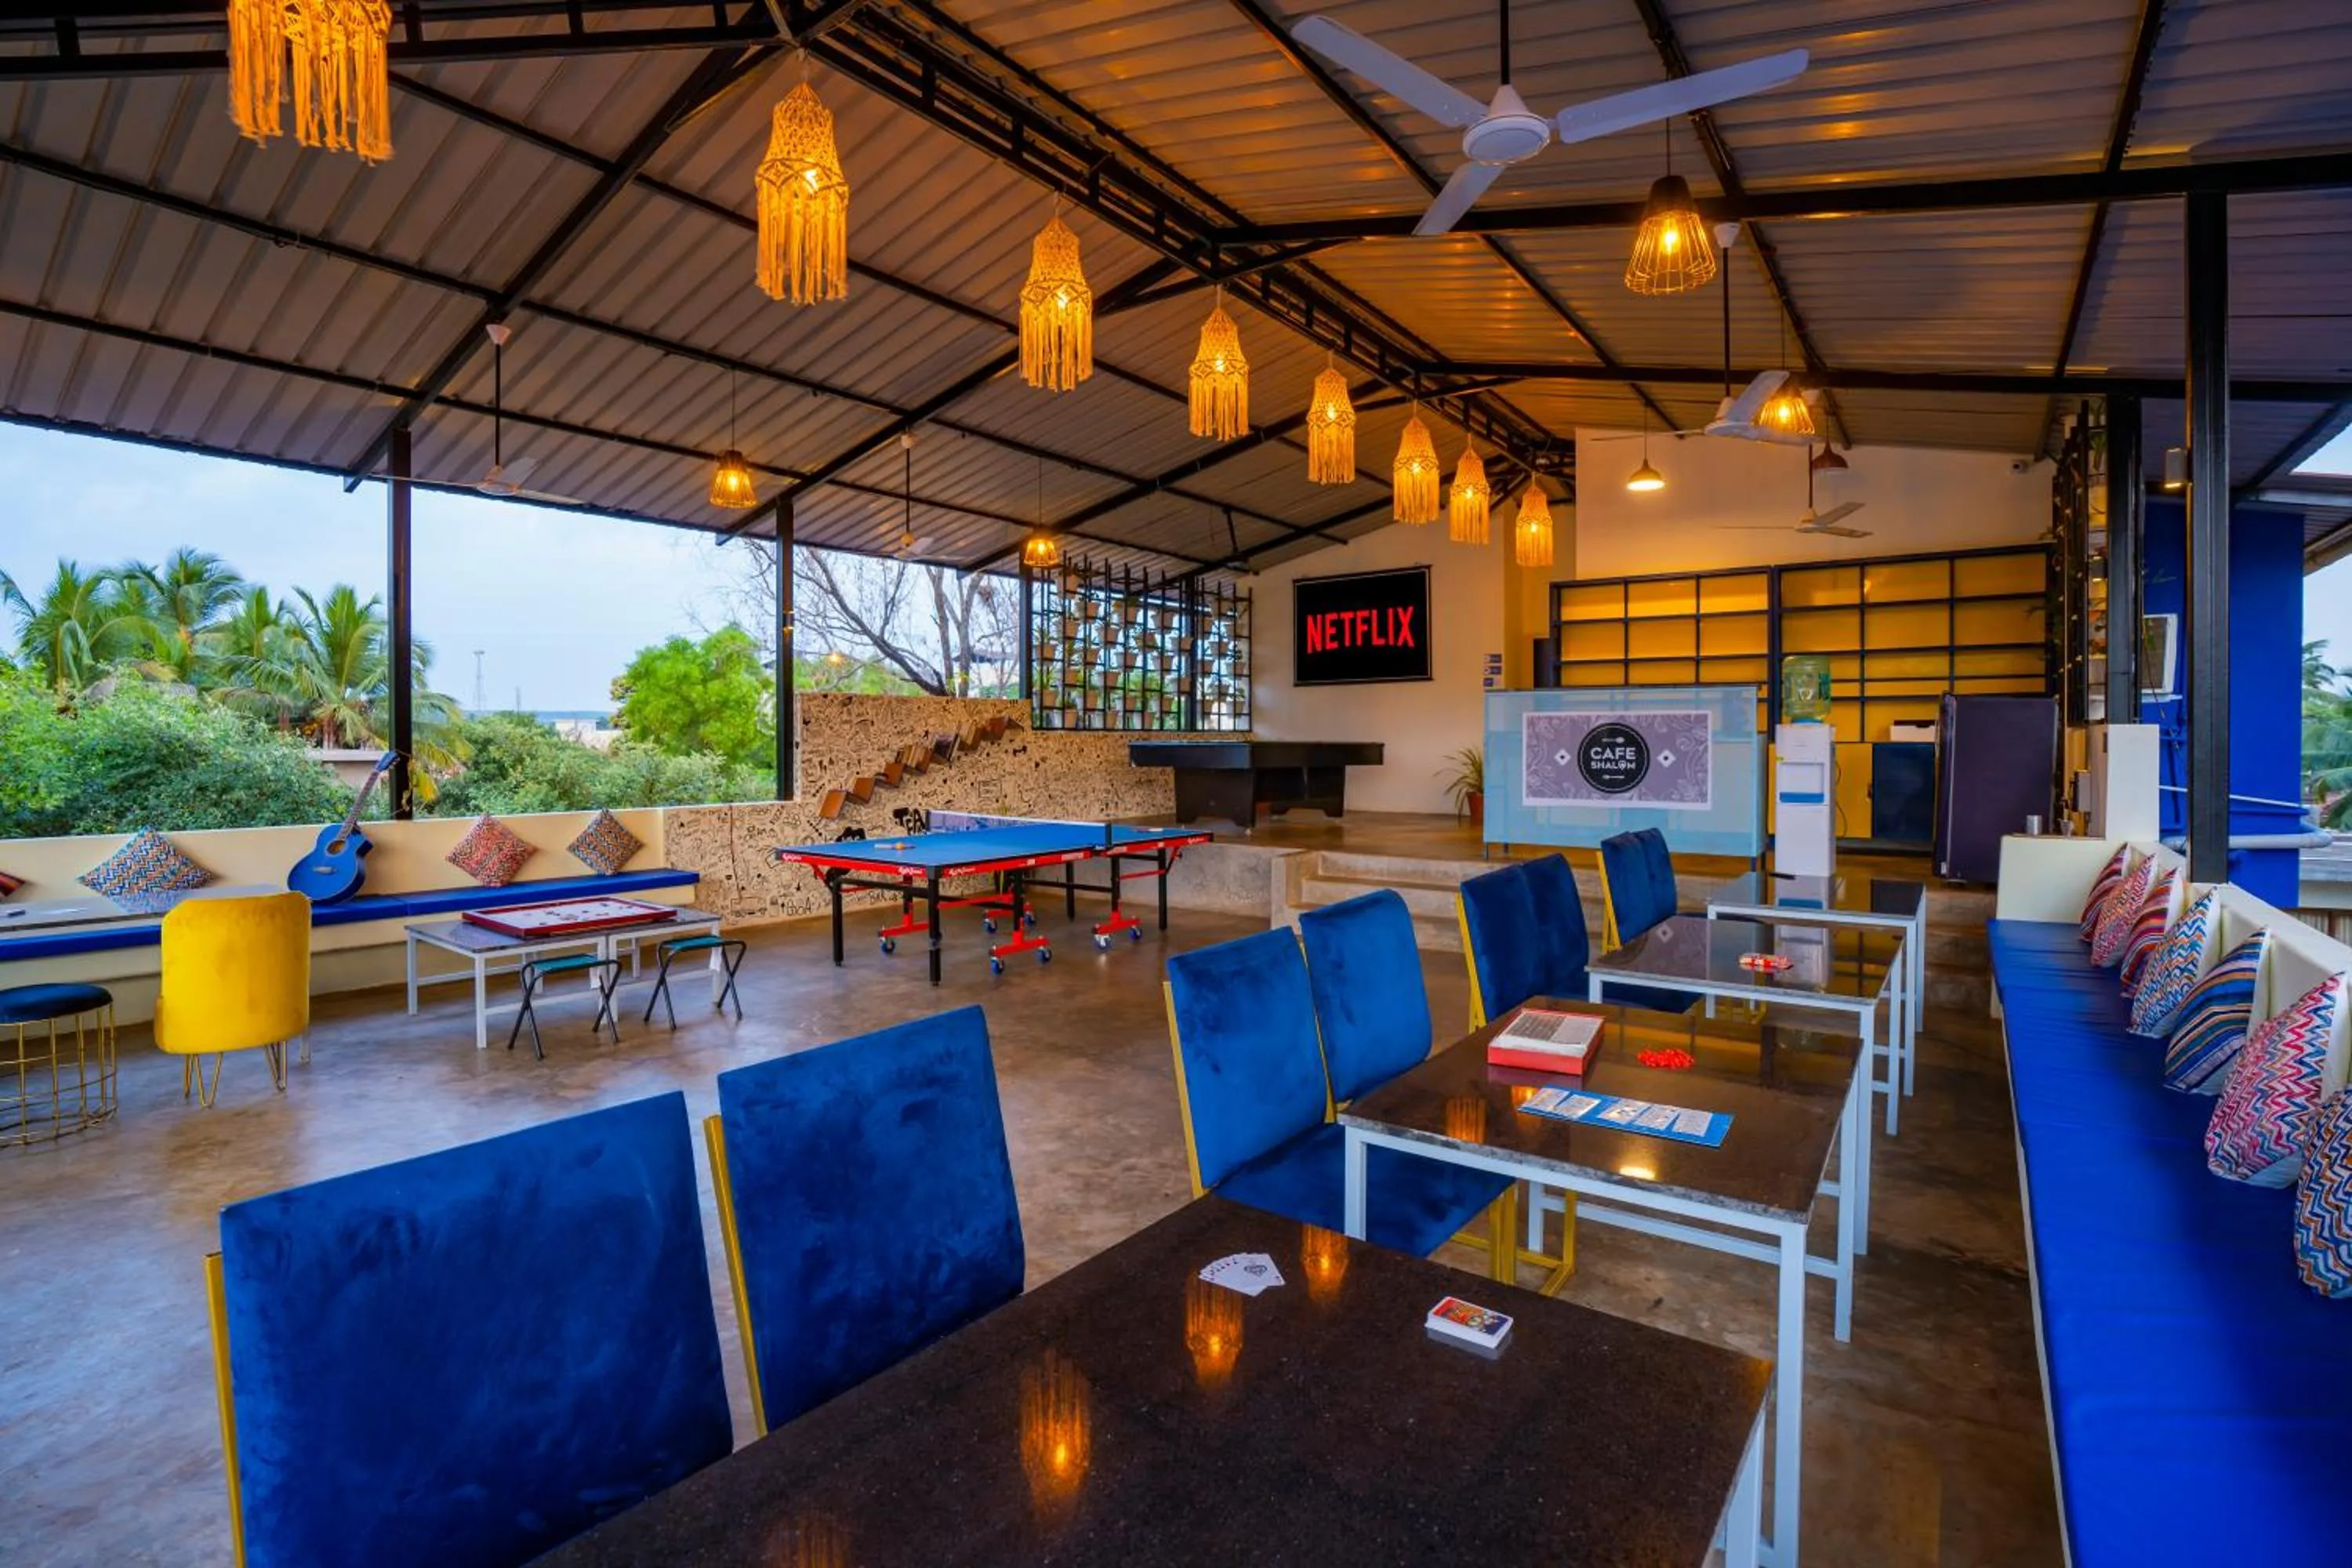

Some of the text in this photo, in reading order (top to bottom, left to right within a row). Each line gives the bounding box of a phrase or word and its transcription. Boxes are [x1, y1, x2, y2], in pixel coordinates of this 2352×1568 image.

[1307, 606, 1414, 654] NETFLIX
[1590, 747, 1636, 760] CAFE
[1591, 760, 1636, 771] SHALOM
